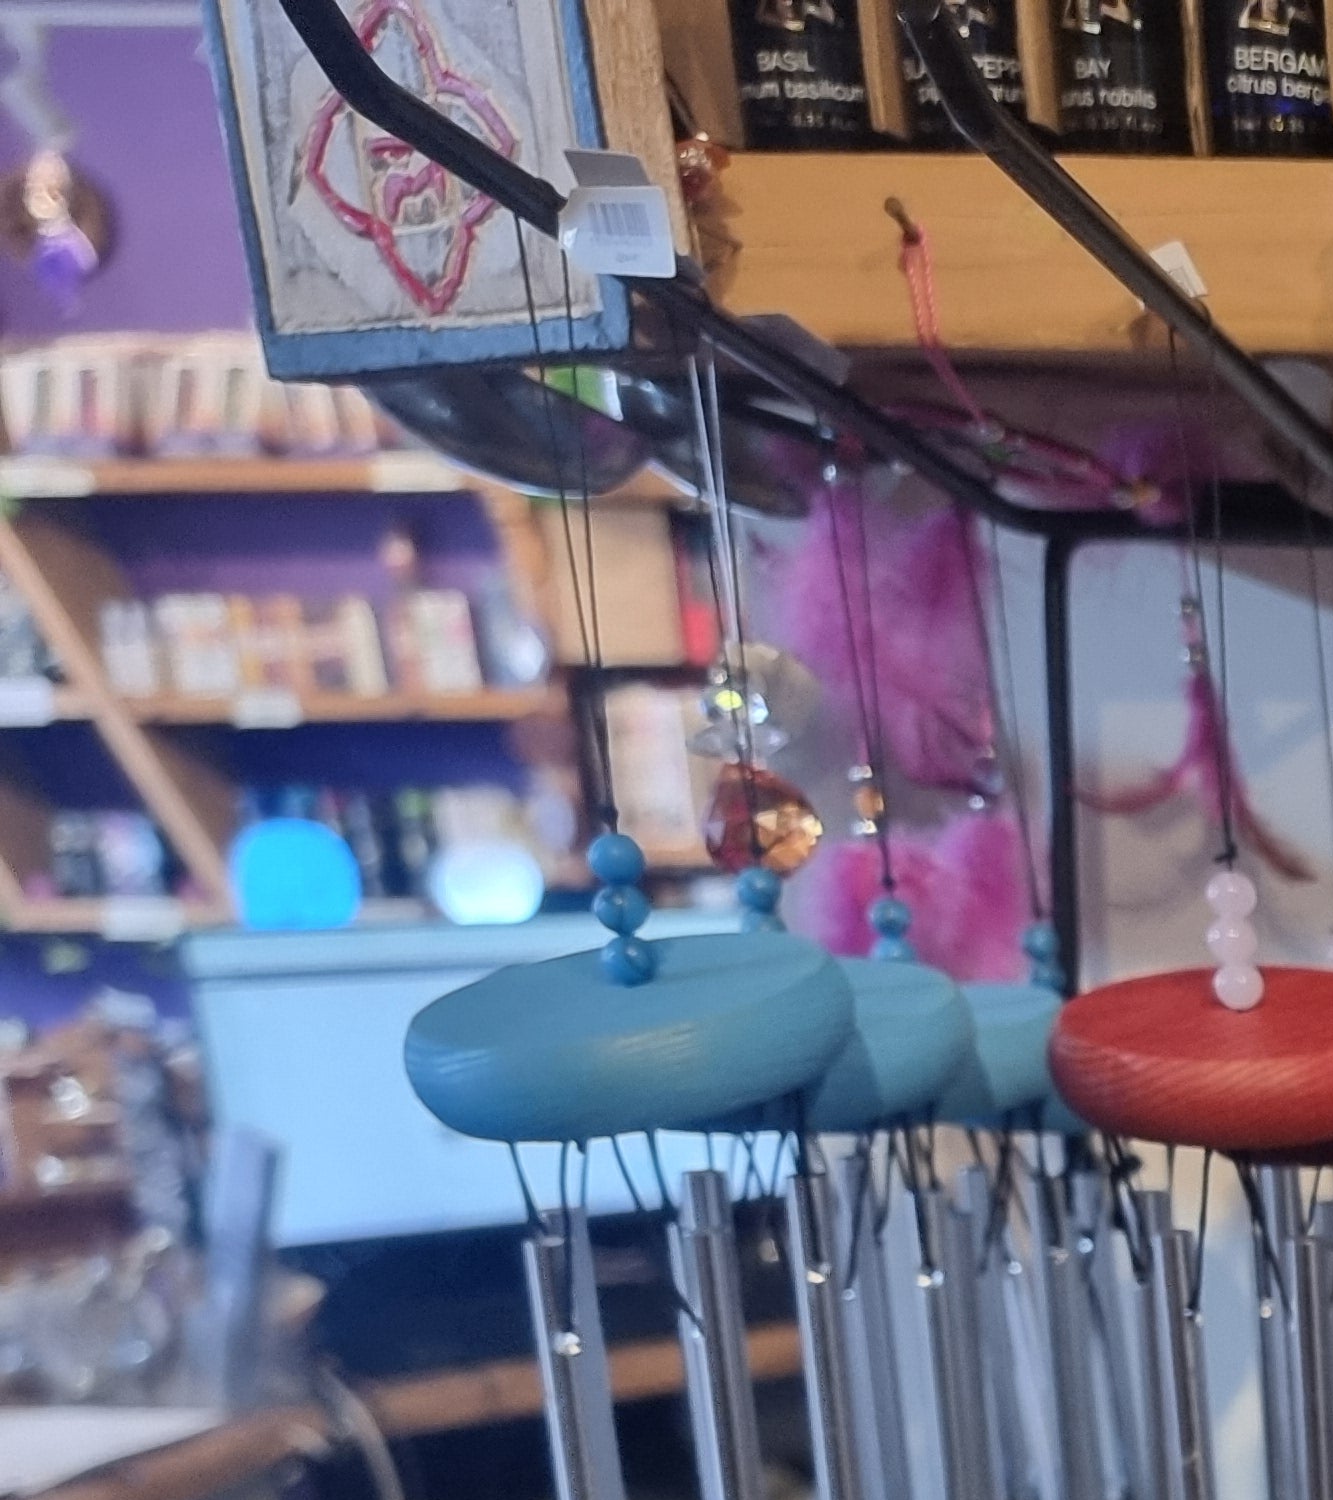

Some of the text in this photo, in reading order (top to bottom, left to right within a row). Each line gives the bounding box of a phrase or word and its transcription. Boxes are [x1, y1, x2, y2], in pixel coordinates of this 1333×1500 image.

[756, 50, 816, 73] BASIL
[1074, 57, 1111, 79] BAY
[1226, 73, 1278, 96] citrus
